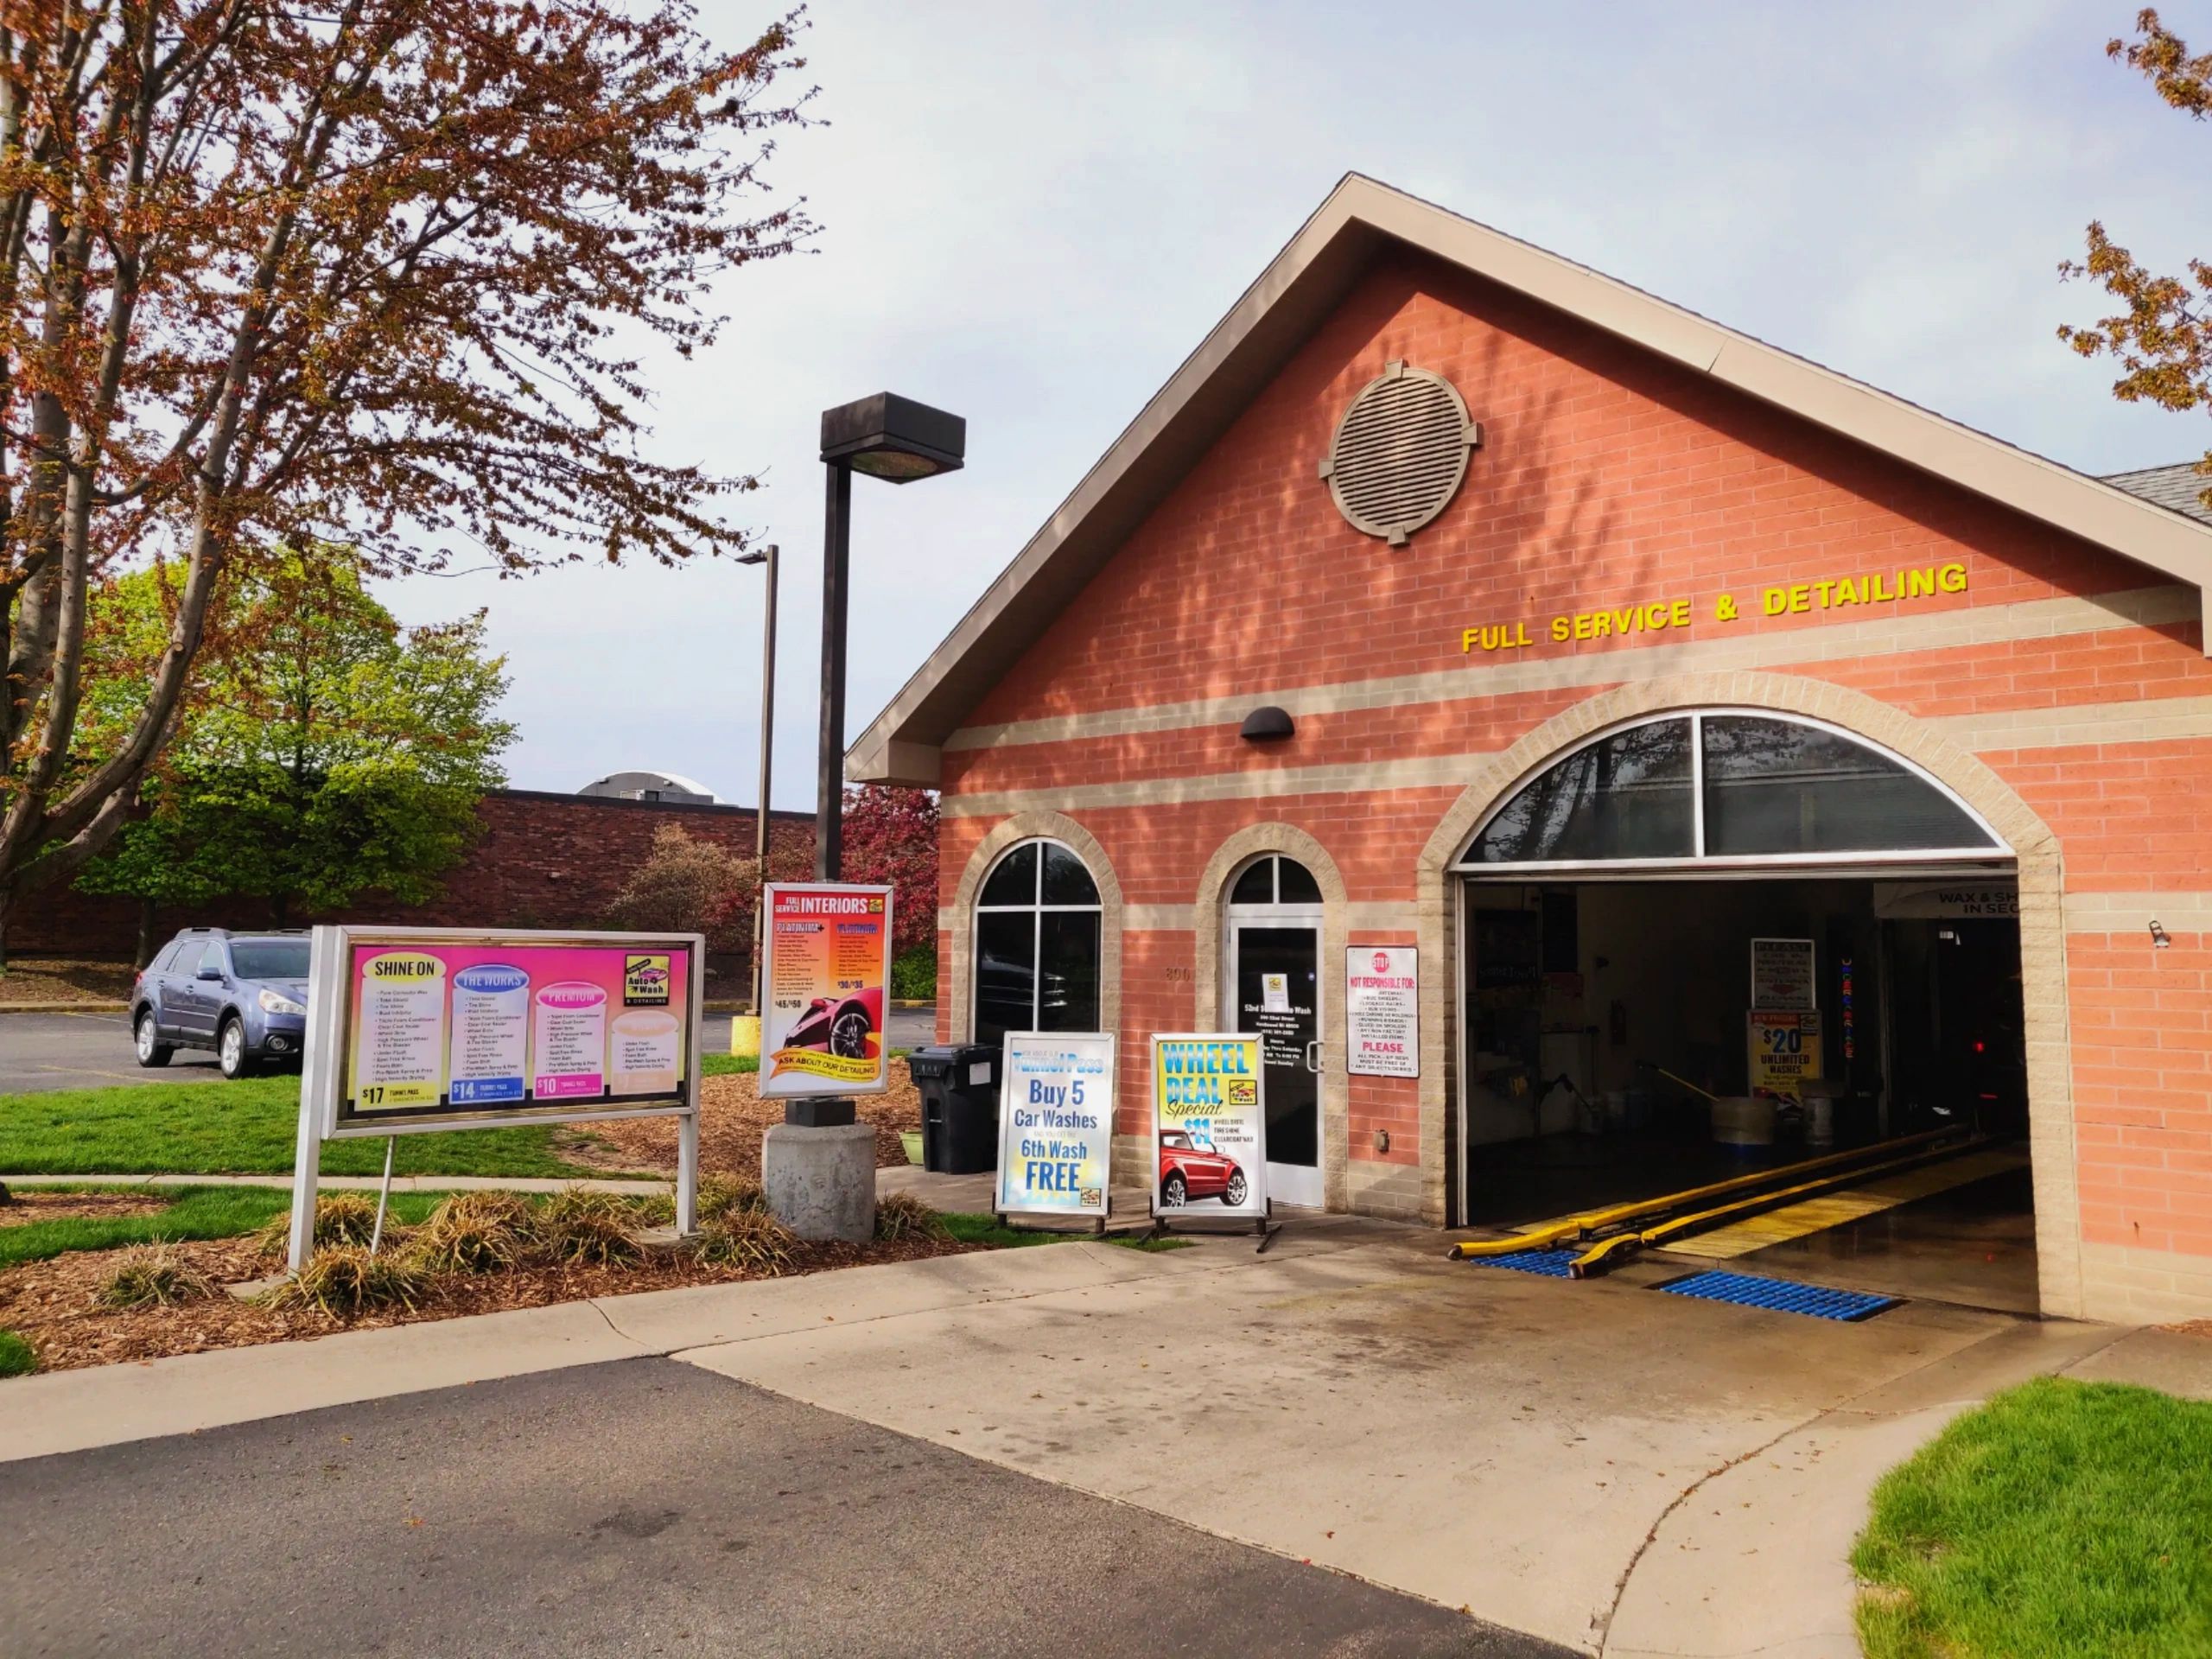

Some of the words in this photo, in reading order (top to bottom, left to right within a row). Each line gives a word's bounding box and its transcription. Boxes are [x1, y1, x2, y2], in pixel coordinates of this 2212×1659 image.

[1462, 620, 1534, 653] FULL
[1551, 601, 1691, 642] SERVICE
[1715, 594, 1738, 622] &
[1764, 563, 1967, 617] DETAILING
[801, 897, 868, 914] INTERIORS
[1939, 893, 1976, 903] WAX
[1980, 893, 1990, 903] &
[774, 905, 800, 913] SERVICE
[1964, 904, 1981, 913] IN
[375, 961, 415, 976] SHINE
[416, 960, 435, 976] ON
[463, 976, 482, 987] THE
[484, 975, 521, 987] WORKS
[628, 976, 649, 985] Auto
[1350, 976, 1362, 988] NOT
[1363, 976, 1401, 988] RESPONSIBLE
[548, 991, 596, 1003] PREMIUM
[639, 985, 664, 994] Wash
[1294, 1006, 1312, 1014] Wash
[1363, 1041, 1404, 1053] PLEASE
[1764, 1028, 1802, 1053] $20
[779, 1057, 794, 1065] ASK
[796, 1058, 822, 1067] ABOUT
[822, 1061, 839, 1071] OUR
[839, 1065, 875, 1075] DETAILING
[1012, 1052, 1065, 1072] Tunnel
[1066, 1052, 1104, 1074] Pass
[1162, 1043, 1250, 1074] WHEEL
[1761, 1054, 1810, 1065] UNLIMITED
[1770, 1065, 1802, 1075] WASHES
[453, 1082, 475, 1099] $14
[537, 1077, 557, 1095] $10
[1029, 1078, 1068, 1109] Buy
[1071, 1080, 1085, 1105] 5
[1166, 1077, 1221, 1105] DEAL
[362, 1087, 385, 1104] $17
[1166, 1098, 1224, 1120] Special
[1014, 1109, 1042, 1128] Car
[1043, 1110, 1098, 1129] Washes
[1183, 1118, 1211, 1145] $11
[1021, 1140, 1046, 1159] 6th
[1049, 1141, 1088, 1160] Wash
[1026, 1161, 1081, 1192] FREE
